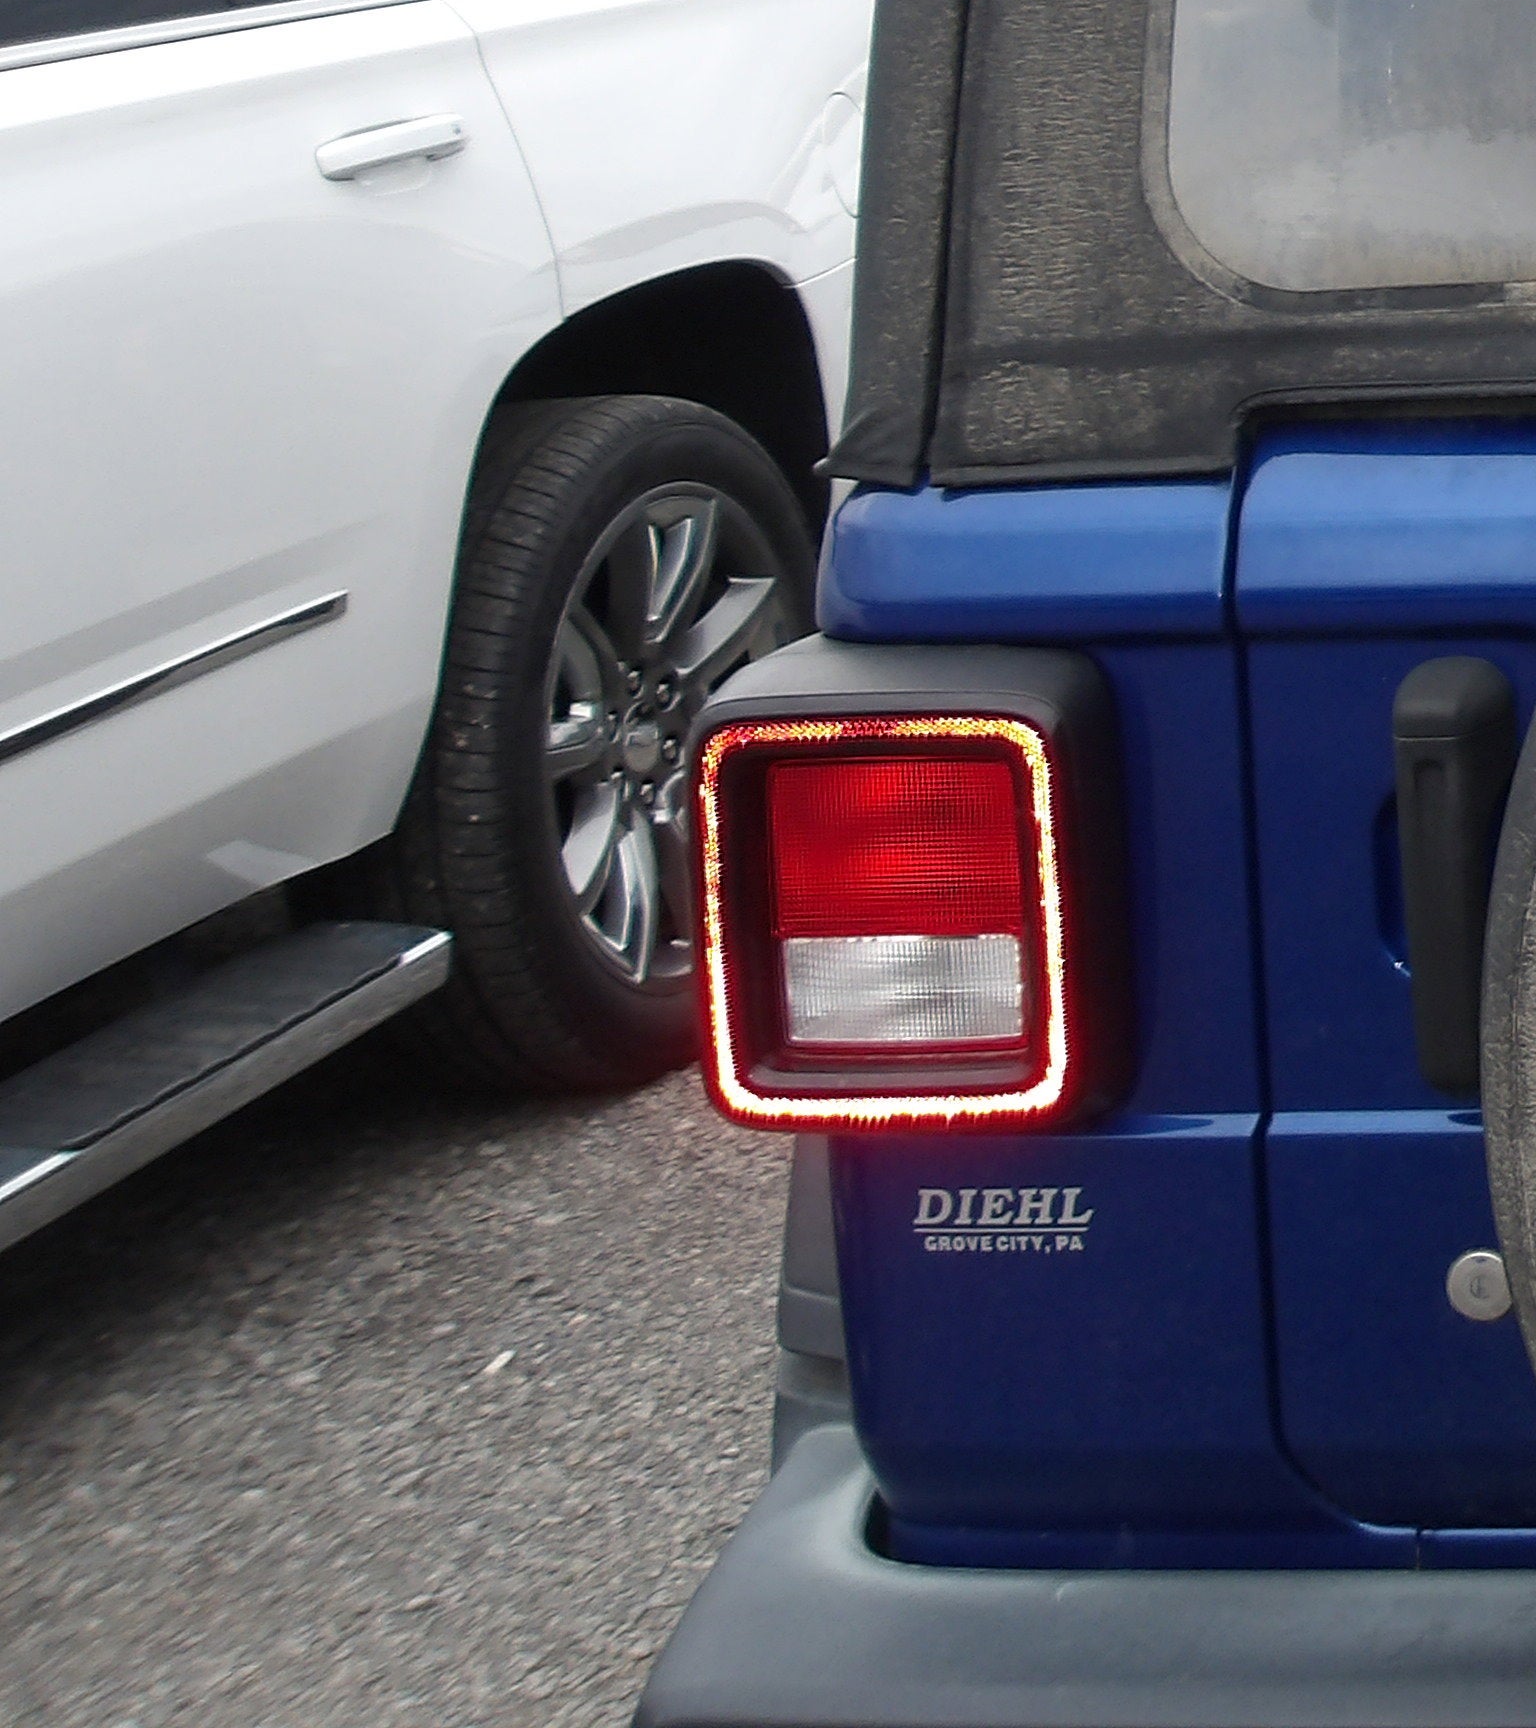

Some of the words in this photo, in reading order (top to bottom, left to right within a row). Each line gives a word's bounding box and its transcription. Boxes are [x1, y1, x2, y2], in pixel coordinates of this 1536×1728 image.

[912, 1187, 1094, 1225] DIEHL
[924, 1235, 993, 1252] GROVE
[996, 1235, 1051, 1253] CITY,
[1055, 1235, 1084, 1251] PA
